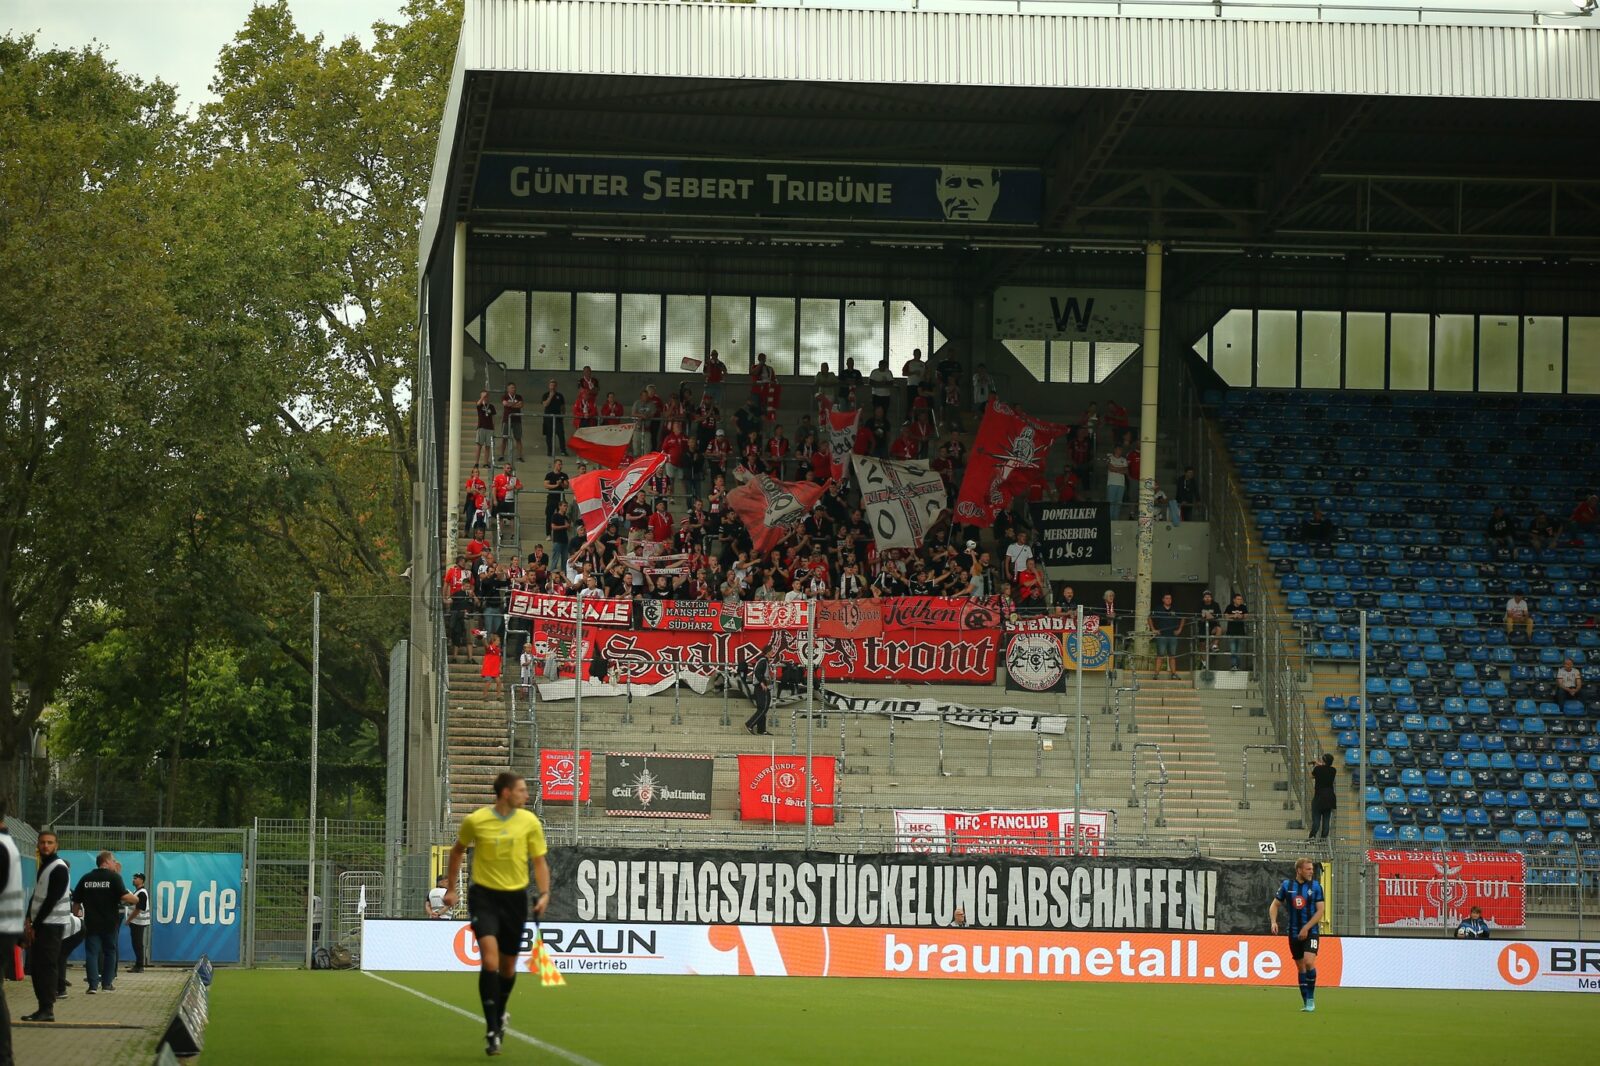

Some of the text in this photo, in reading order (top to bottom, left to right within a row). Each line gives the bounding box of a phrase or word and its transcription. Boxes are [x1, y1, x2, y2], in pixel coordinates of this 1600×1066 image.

[510, 166, 892, 204] GÜNTER SEBERT TRIBÜNE
[1050, 296, 1095, 332] W
[1042, 507, 1097, 521] DOMFALKEN
[1043, 527, 1098, 541] MERSEBURG
[513, 595, 630, 622] SURREALE
[675, 600, 709, 609] SEKTION
[666, 608, 718, 617] MANSFELD
[669, 619, 713, 630] SÜDHARZ
[602, 632, 762, 678] Saale
[612, 787, 632, 797] Exil
[955, 816, 980, 830] HFC
[990, 815, 1048, 830] FANCLUB
[1260, 843, 1274, 852] 26
[84, 881, 110, 889] ORDNER
[577, 854, 1217, 930] SPIELTAGSZERSTÜCKELUNG ABSCHAFFEN!
[1385, 879, 1509, 900] HALLE LUJA
[156, 879, 236, 925] 07.de
[1310, 938, 1318, 949] 18
[885, 934, 1282, 978] braunmetall.de
[578, 959, 627, 971] Vertrieb
